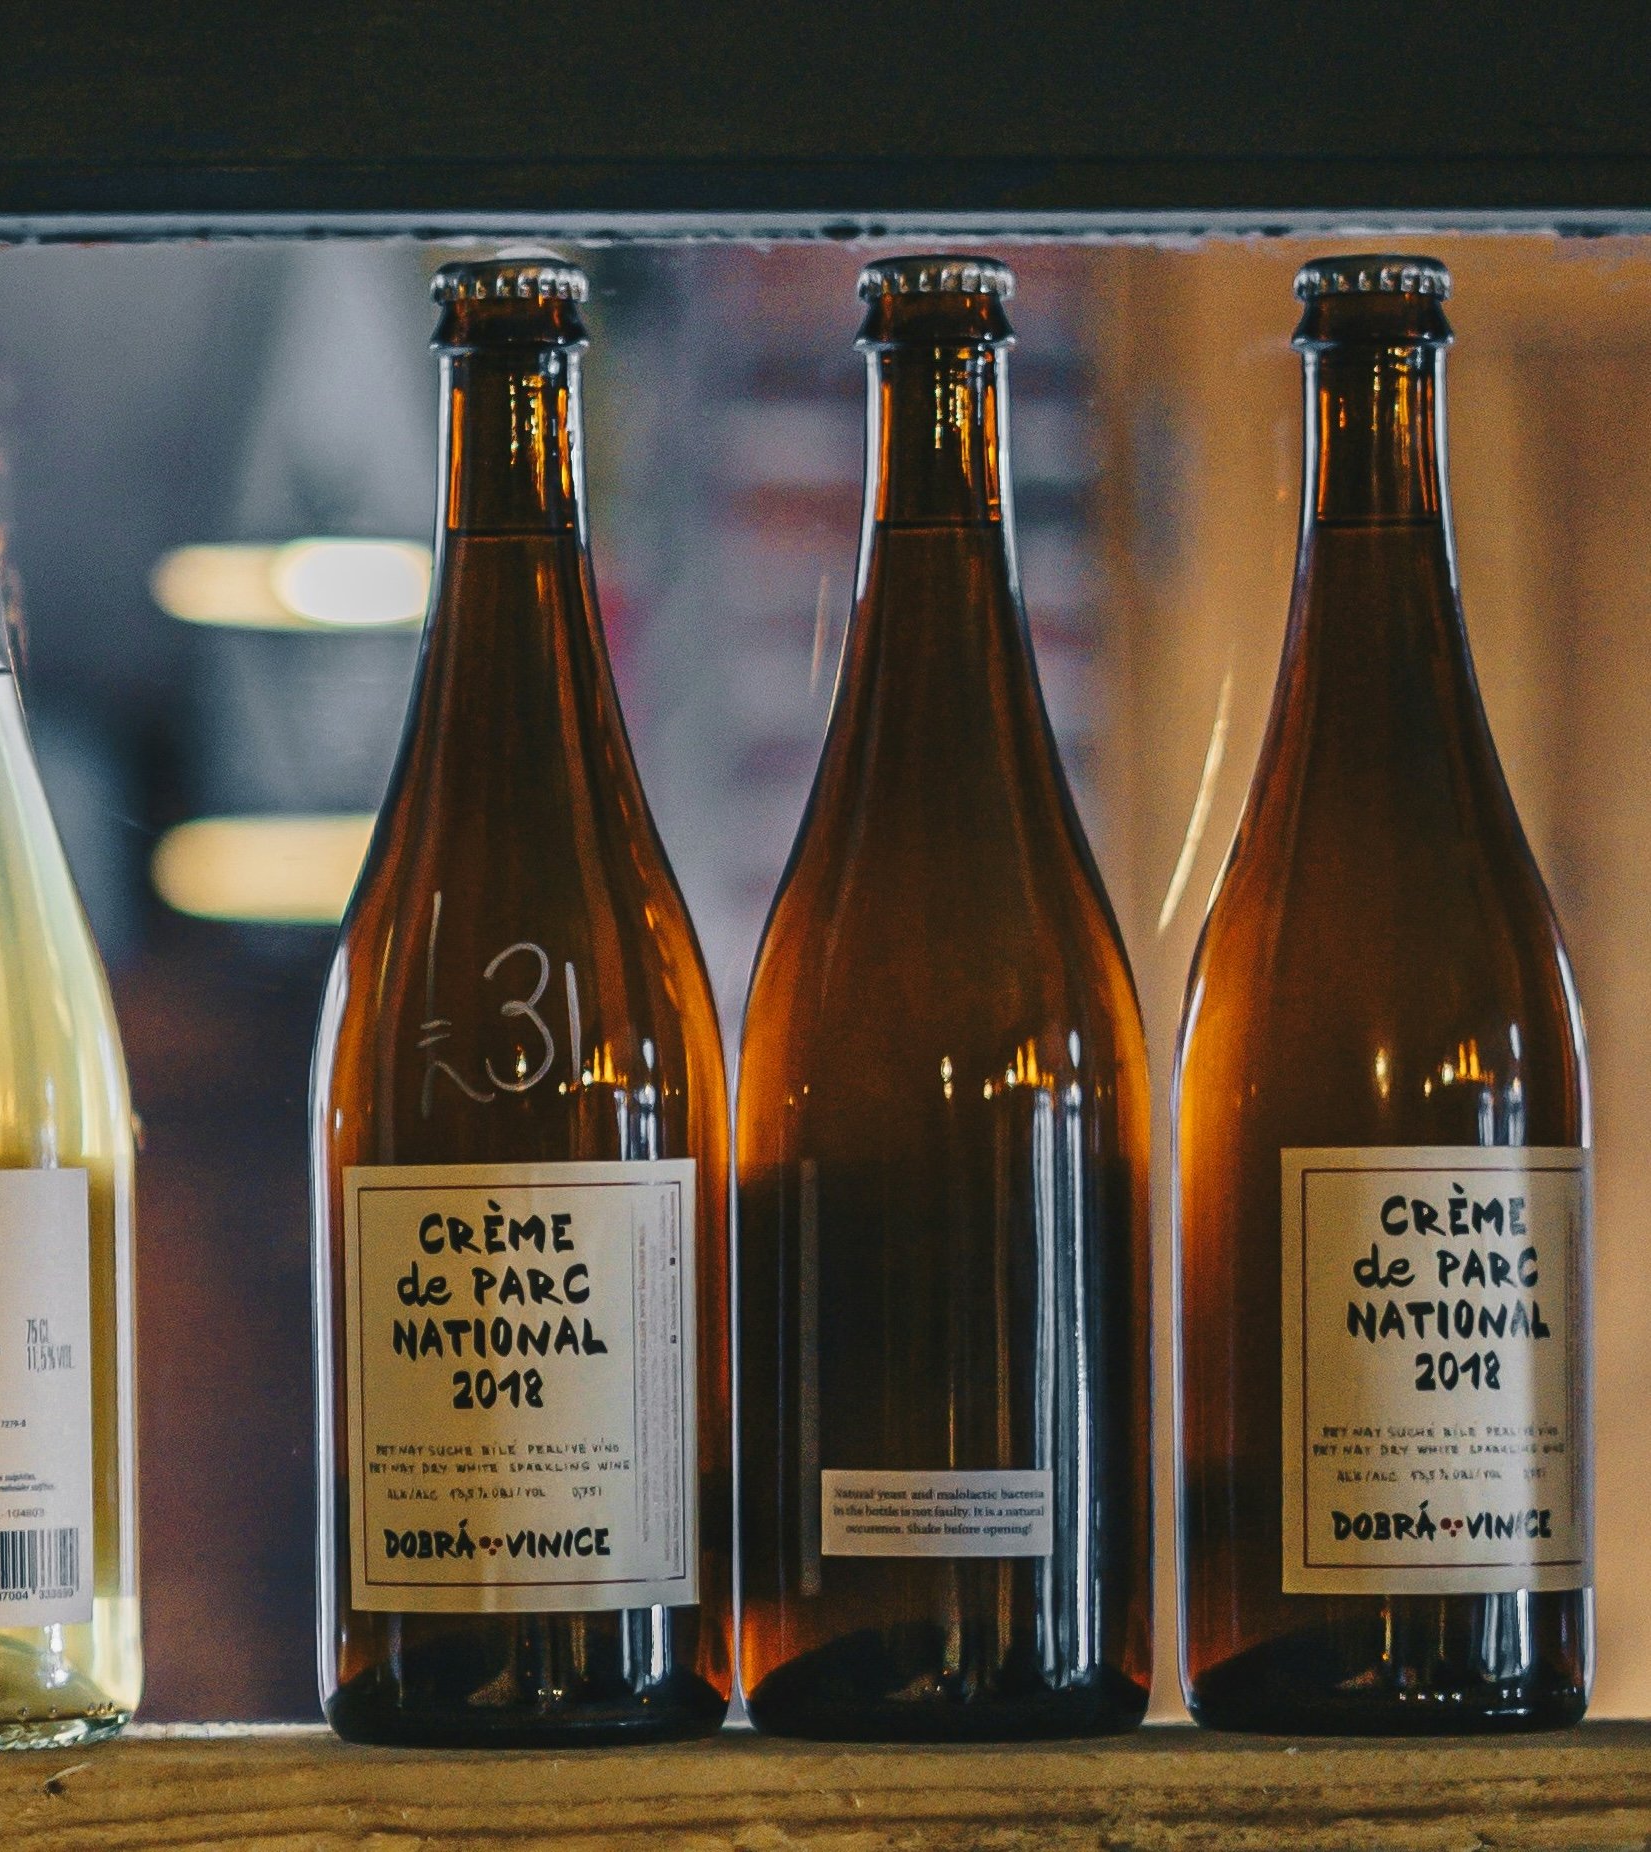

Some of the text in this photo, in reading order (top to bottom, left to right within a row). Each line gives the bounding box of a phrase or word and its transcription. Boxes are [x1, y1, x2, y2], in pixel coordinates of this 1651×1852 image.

[418, 1200, 574, 1255] CRÈME
[1380, 1182, 1527, 1238] CRÈME
[397, 1260, 591, 1306] de PARC
[1353, 1242, 1539, 1289] de PARC
[26, 1319, 38, 1344] 75
[392, 1316, 608, 1362] NATIONAL
[1346, 1299, 1551, 1343] NATIONAL
[452, 1367, 544, 1410] 2018
[1414, 1349, 1501, 1392] 2018
[509, 1460, 590, 1473] SPARKLING
[833, 1506, 845, 1517] in
[846, 1505, 864, 1517] the
[865, 1505, 898, 1517] bottle
[913, 1507, 932, 1517] not
[1005, 1505, 1045, 1517] natural
[877, 1490, 907, 1501] yeast
[911, 1487, 933, 1500] and
[1000, 1488, 1044, 1499] bacteria
[383, 1518, 610, 1559] DOBRÁ VINICE
[907, 1523, 941, 1535] Shake
[943, 1523, 982, 1535] before
[1331, 1499, 1552, 1542] DOBRÁ VINICE
